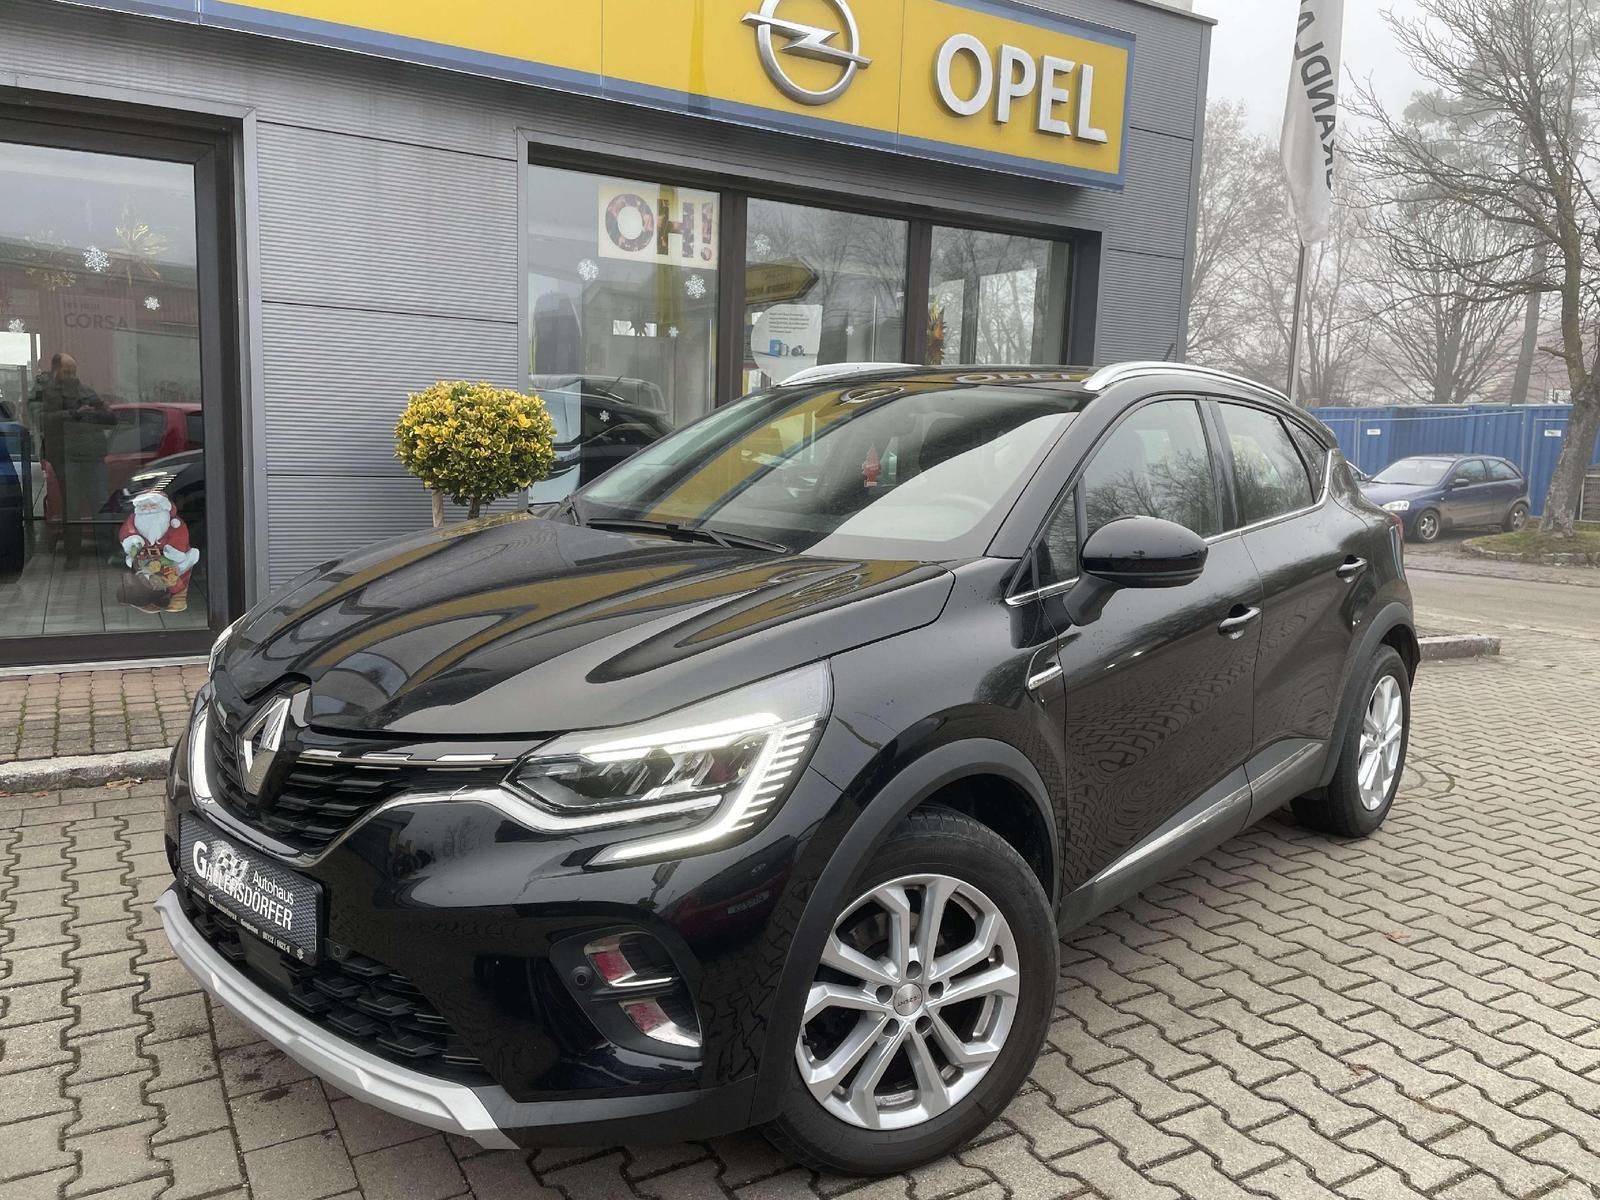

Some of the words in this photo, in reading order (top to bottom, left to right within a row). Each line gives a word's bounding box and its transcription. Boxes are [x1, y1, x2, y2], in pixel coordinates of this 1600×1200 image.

[936, 33, 1108, 143] OPEL
[605, 193, 713, 261] OH!
[64, 313, 128, 329] CORSA
[193, 841, 293, 930] GALLERSDÖRFER
[253, 871, 294, 905] Autohaus
